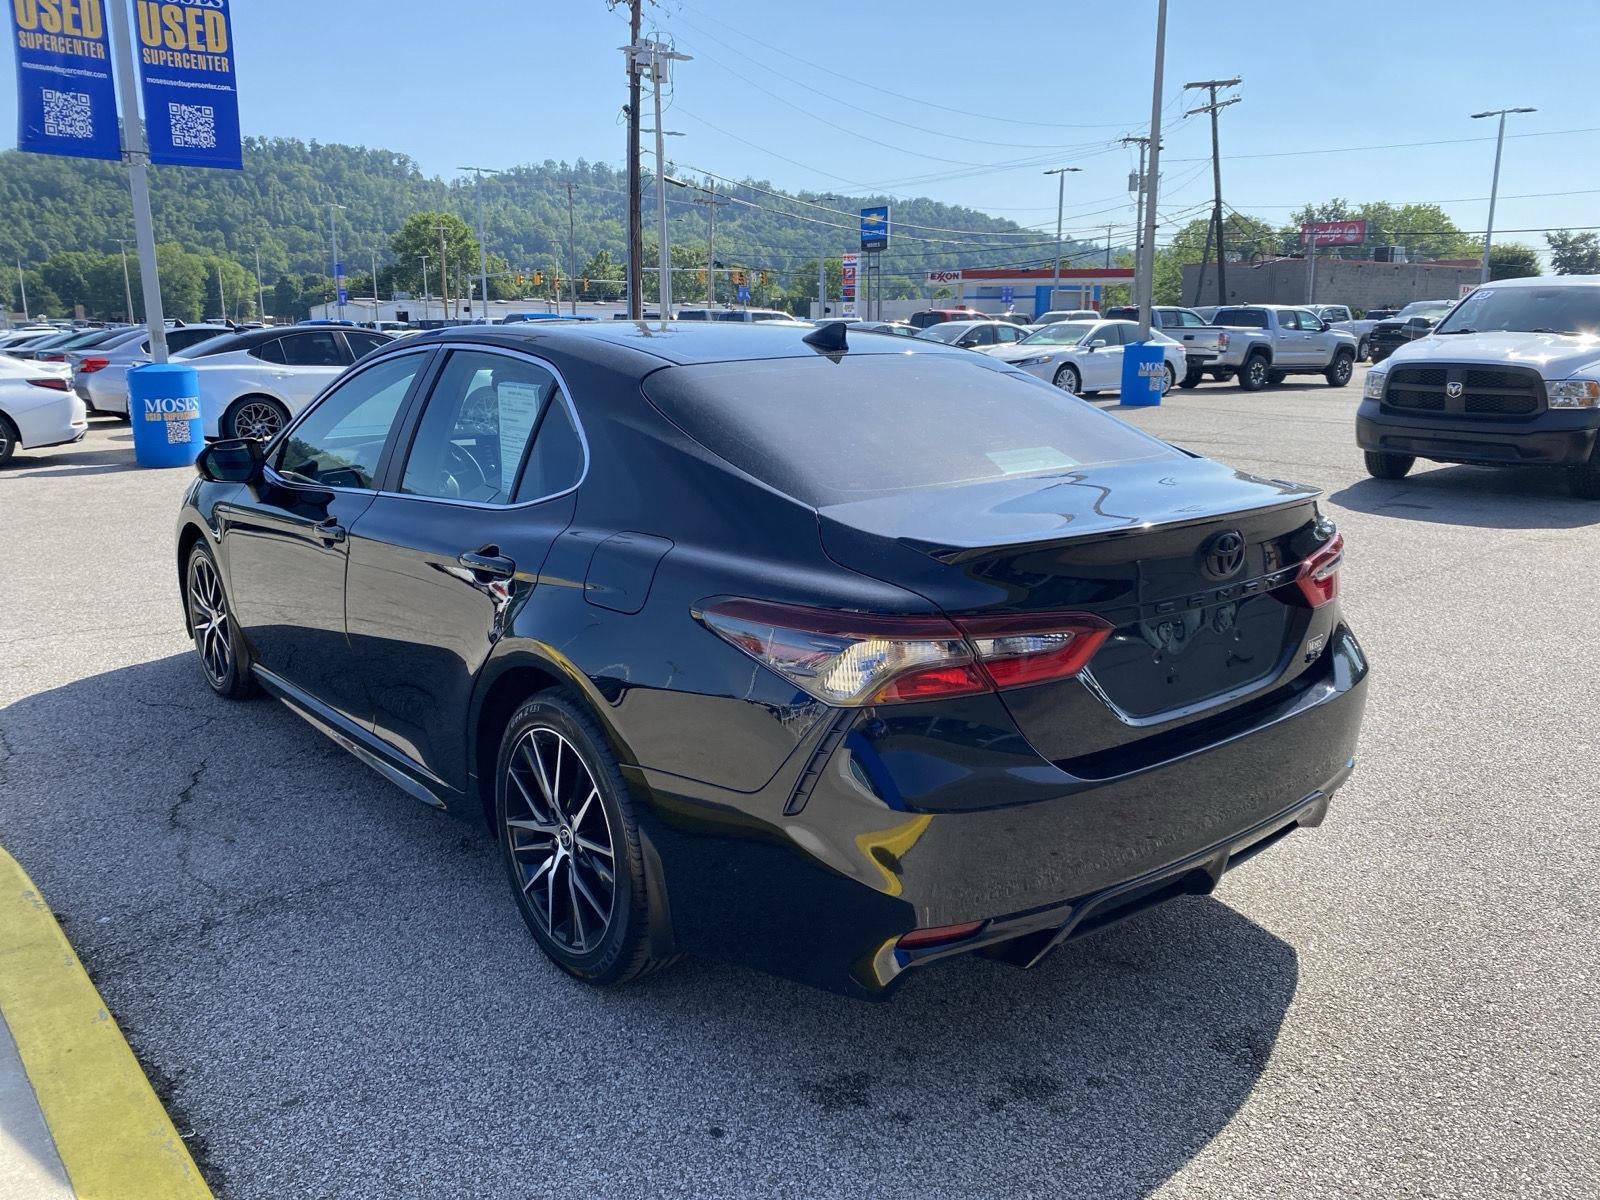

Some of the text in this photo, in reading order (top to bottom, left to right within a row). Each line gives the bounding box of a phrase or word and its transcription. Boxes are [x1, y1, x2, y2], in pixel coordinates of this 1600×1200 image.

[14, 0, 103, 39] USED
[137, 0, 228, 54] USED
[18, 31, 105, 59] SUPERCENTER
[142, 47, 230, 72] SUPERCENTER
[930, 271, 960, 283] EXXON
[143, 396, 199, 413] MOSES
